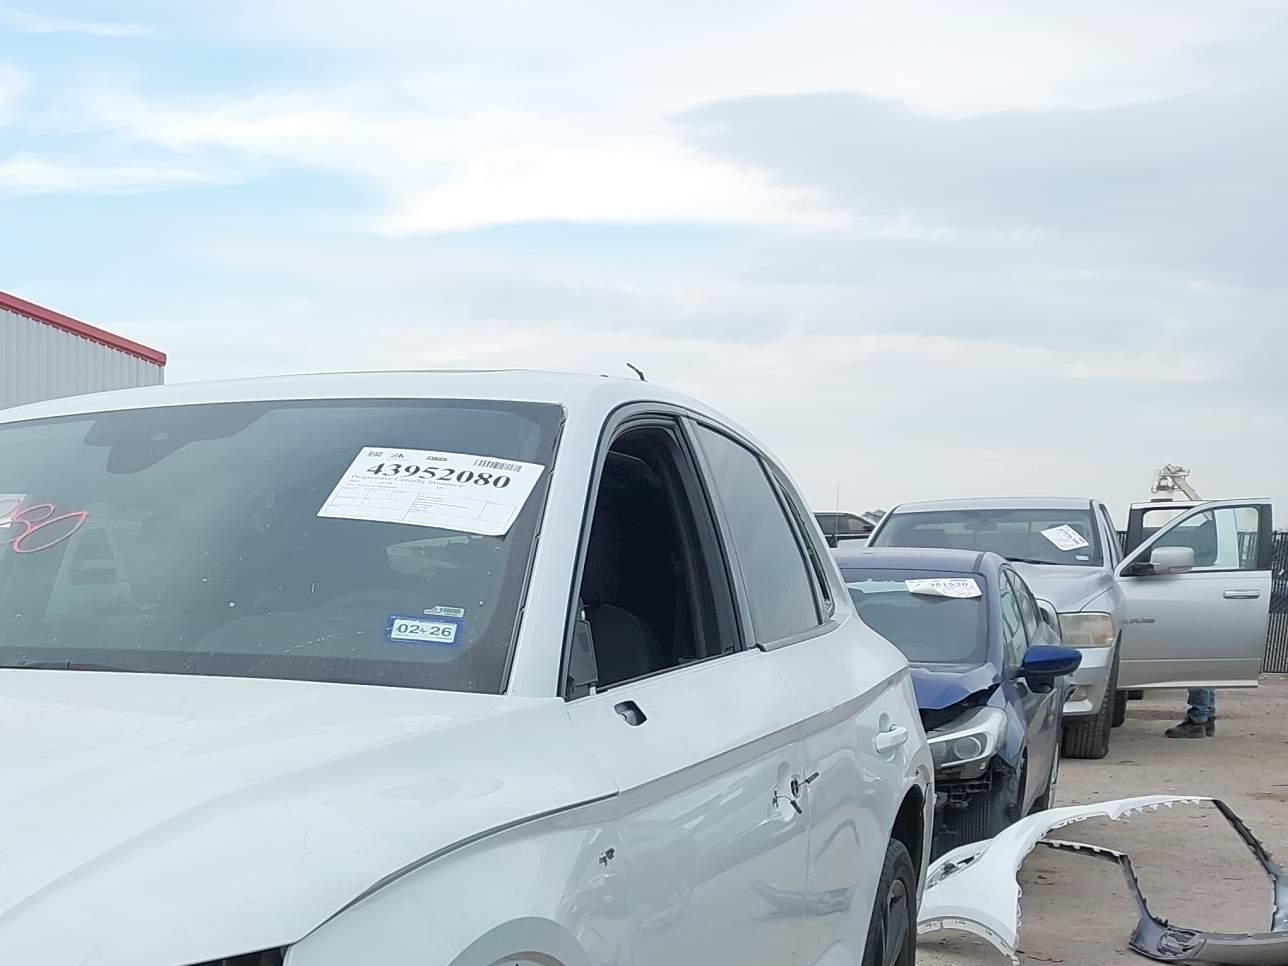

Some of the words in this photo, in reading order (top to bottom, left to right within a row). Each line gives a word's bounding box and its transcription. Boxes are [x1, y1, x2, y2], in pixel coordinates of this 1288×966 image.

[367, 462, 512, 489] 43952080
[398, 623, 420, 634] 02
[429, 626, 453, 637] 26
